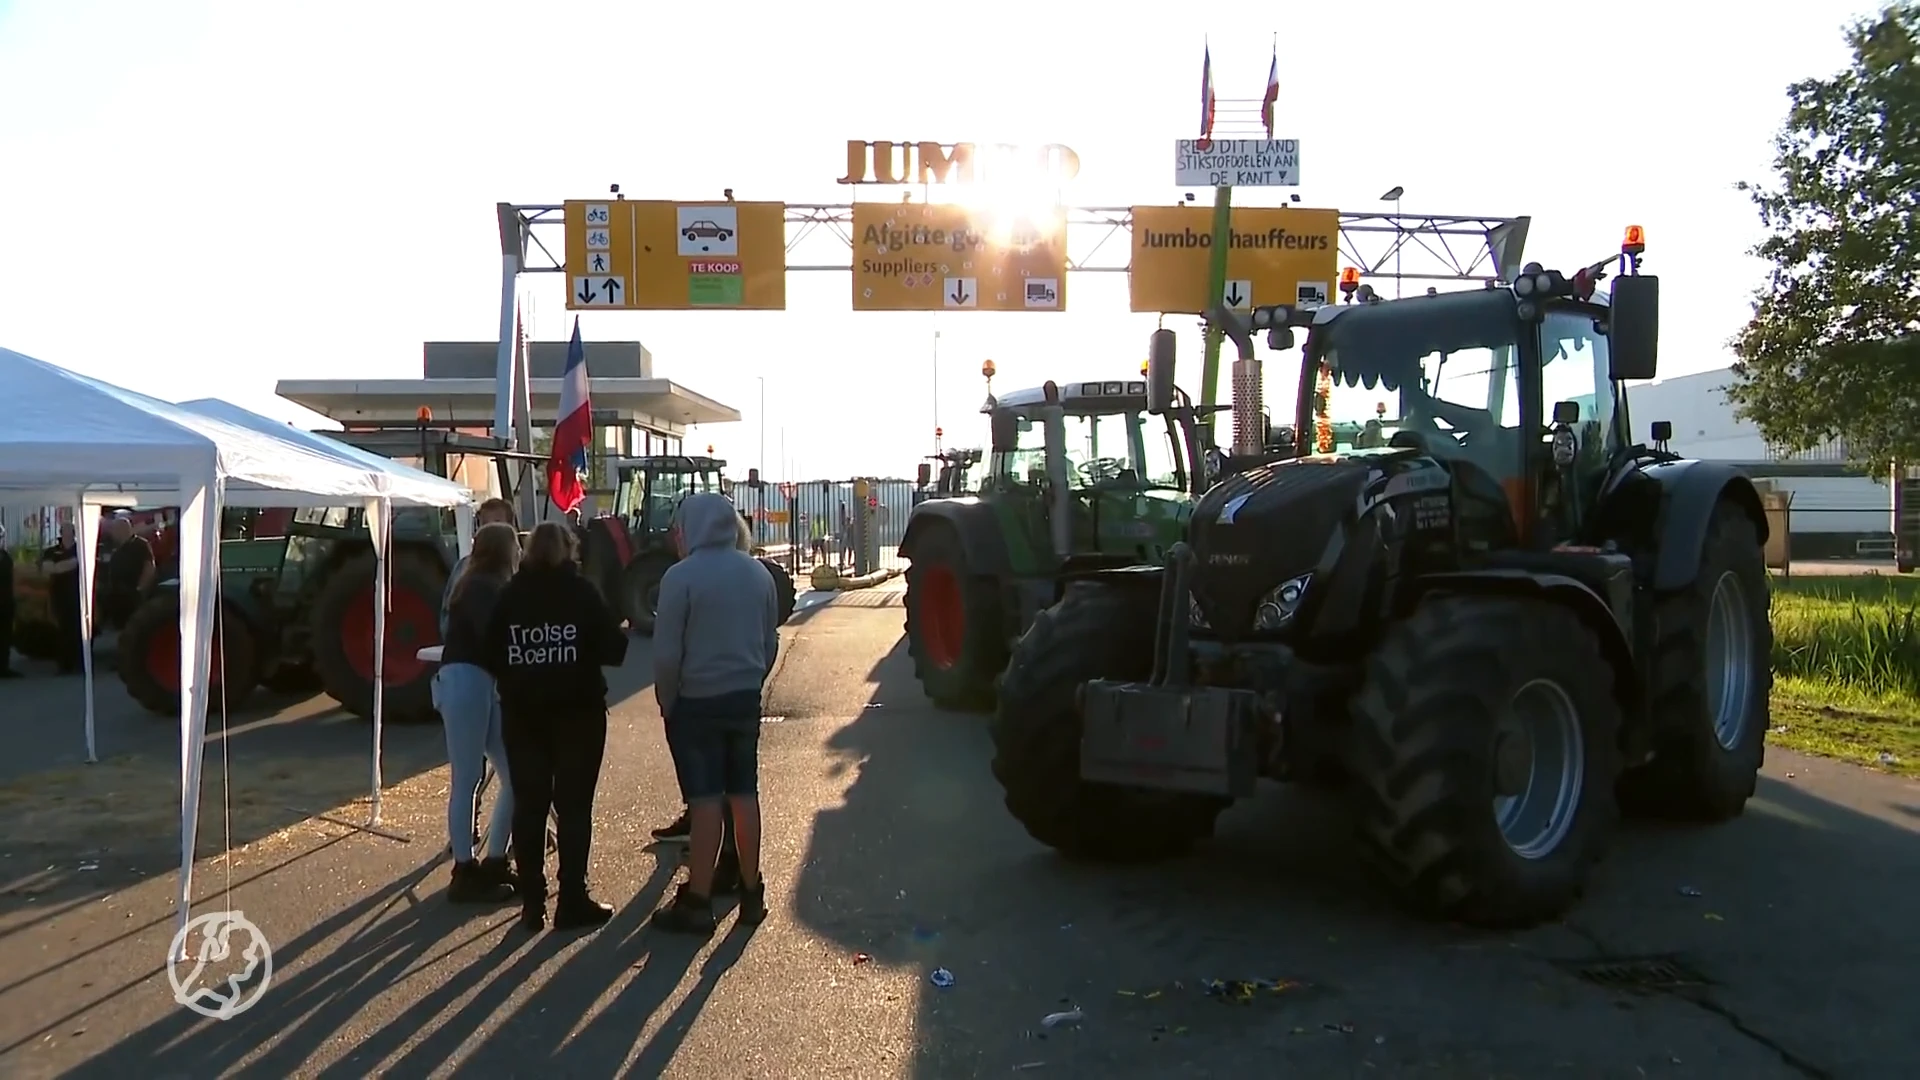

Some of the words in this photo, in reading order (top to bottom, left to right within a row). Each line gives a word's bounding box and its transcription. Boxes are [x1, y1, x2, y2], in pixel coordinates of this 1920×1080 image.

[1220, 139, 1248, 154] DIT
[1256, 139, 1295, 154] LAND
[837, 140, 1080, 184] JUMO
[1176, 154, 1271, 171] STIKSTOFDOELEN
[1274, 154, 1298, 168] AAN
[1210, 171, 1228, 185] DE
[1237, 171, 1273, 185] KANT
[862, 223, 944, 251] Afgifte
[1141, 228, 1212, 249] Jumbo
[1214, 228, 1328, 250] hauffeurs
[691, 262, 705, 273] TE
[707, 262, 739, 273] KOOP
[862, 258, 937, 277] Suppliers
[509, 622, 577, 645] Trotse
[508, 641, 577, 666] Boerin
